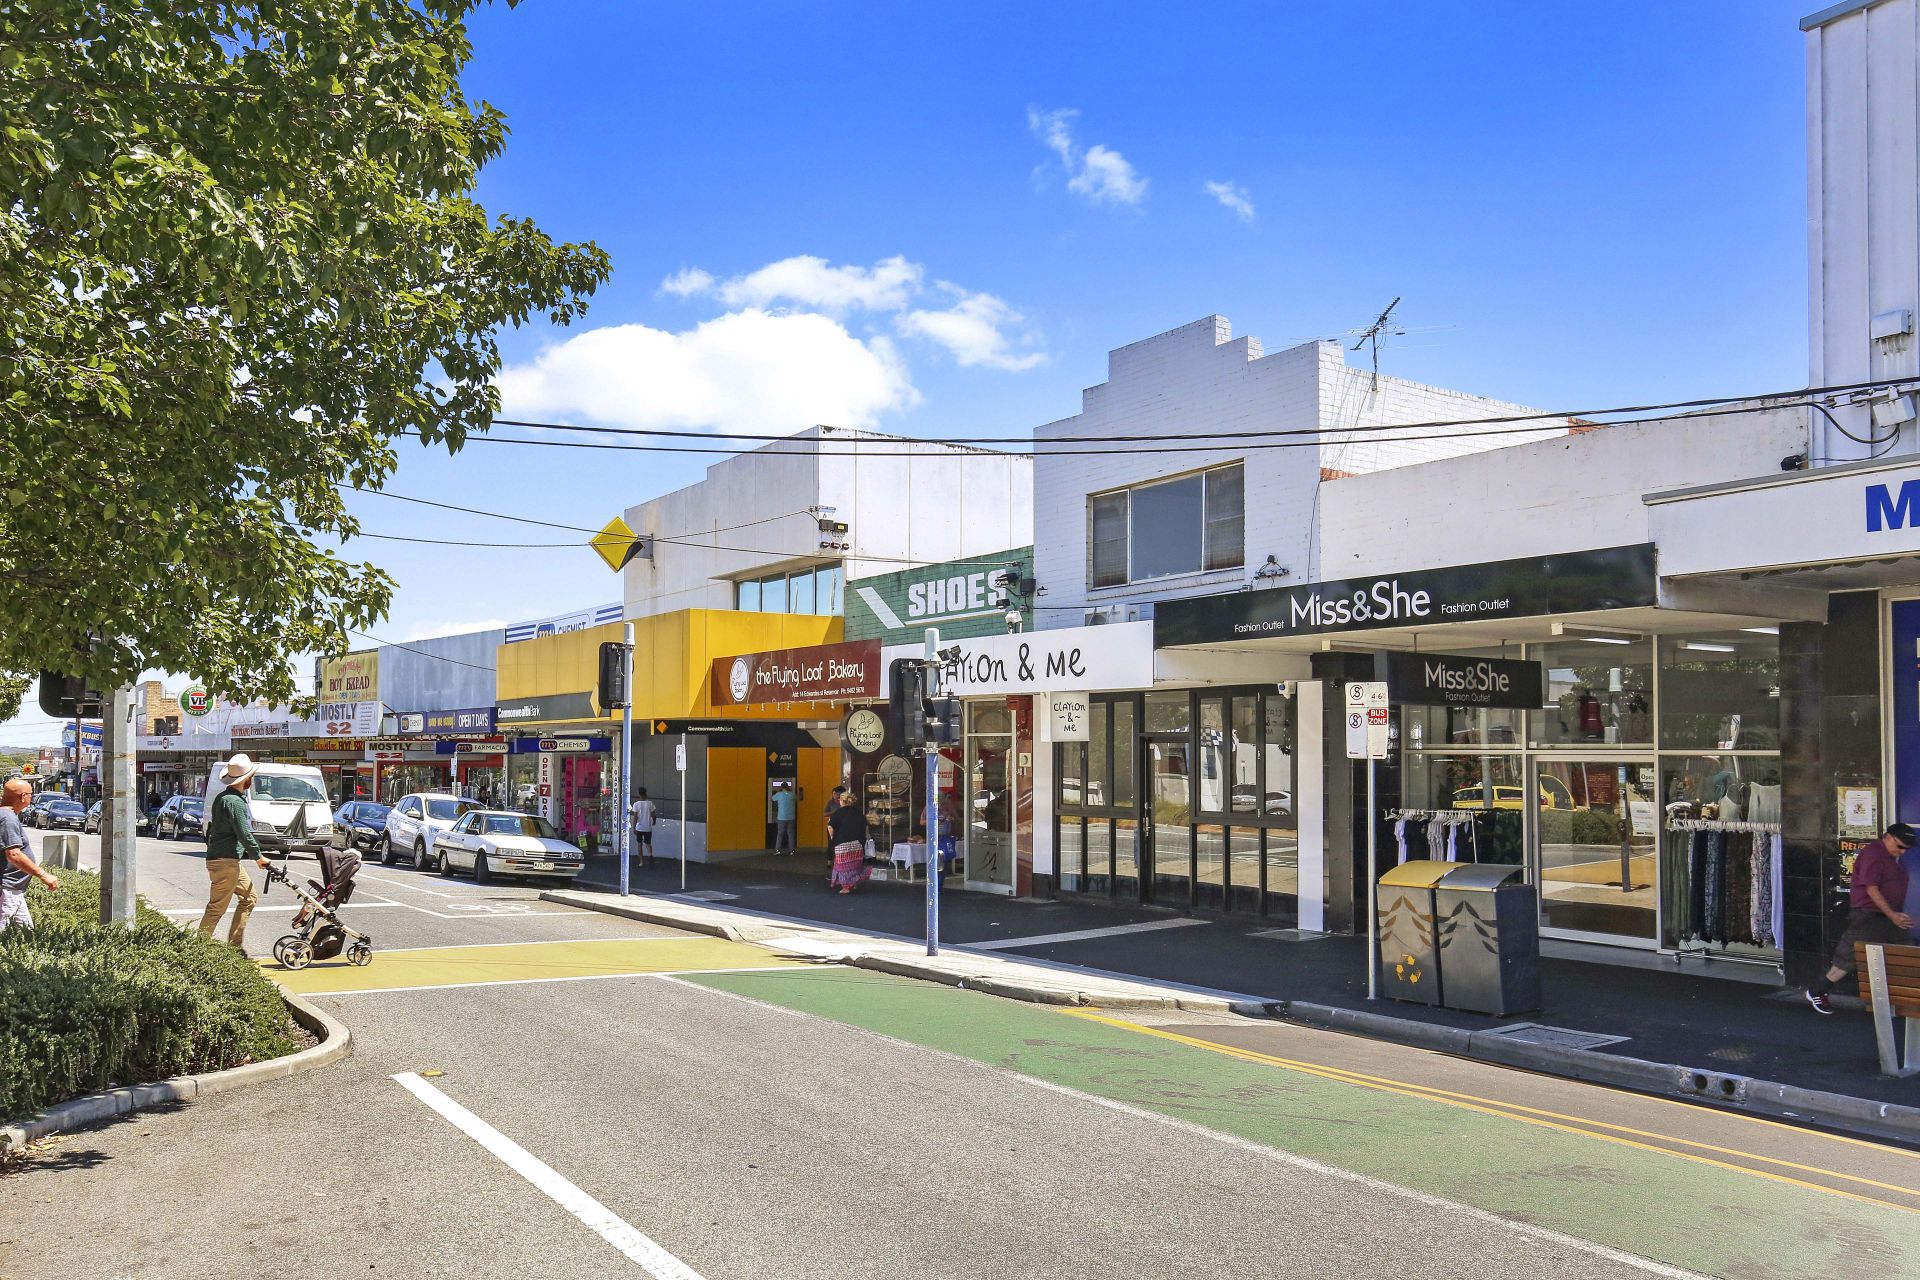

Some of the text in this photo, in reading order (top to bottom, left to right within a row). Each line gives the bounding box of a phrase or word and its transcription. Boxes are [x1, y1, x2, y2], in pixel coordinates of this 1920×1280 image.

[1866, 479, 1920, 532] M
[907, 568, 1008, 617] SHOES
[1234, 580, 1510, 634] Fashion Outlet Miss&She Fashion Outlet
[1018, 642, 1035, 682] &
[756, 658, 864, 688] the Flying Loaf Bakery
[1425, 661, 1510, 692] Miss&She
[329, 675, 370, 692] HOT BREAD
[190, 697, 207, 705] VB
[1445, 691, 1491, 703] Fashion Outlet
[321, 702, 357, 720] MOSTLY
[1370, 709, 1385, 717] BUS
[458, 714, 471, 728] OPEN
[471, 714, 475, 727] 7
[475, 713, 489, 727] DAYS
[1368, 717, 1387, 725] ZONE
[250, 726, 265, 736] French
[265, 725, 280, 737] Bakery
[326, 721, 352, 736] $2
[850, 730, 882, 740] Flying Loaf
[368, 742, 412, 751] MOSTLY
[474, 743, 506, 751] FARMACIA
[540, 741, 557, 750] my
[856, 738, 876, 748] Bakery
